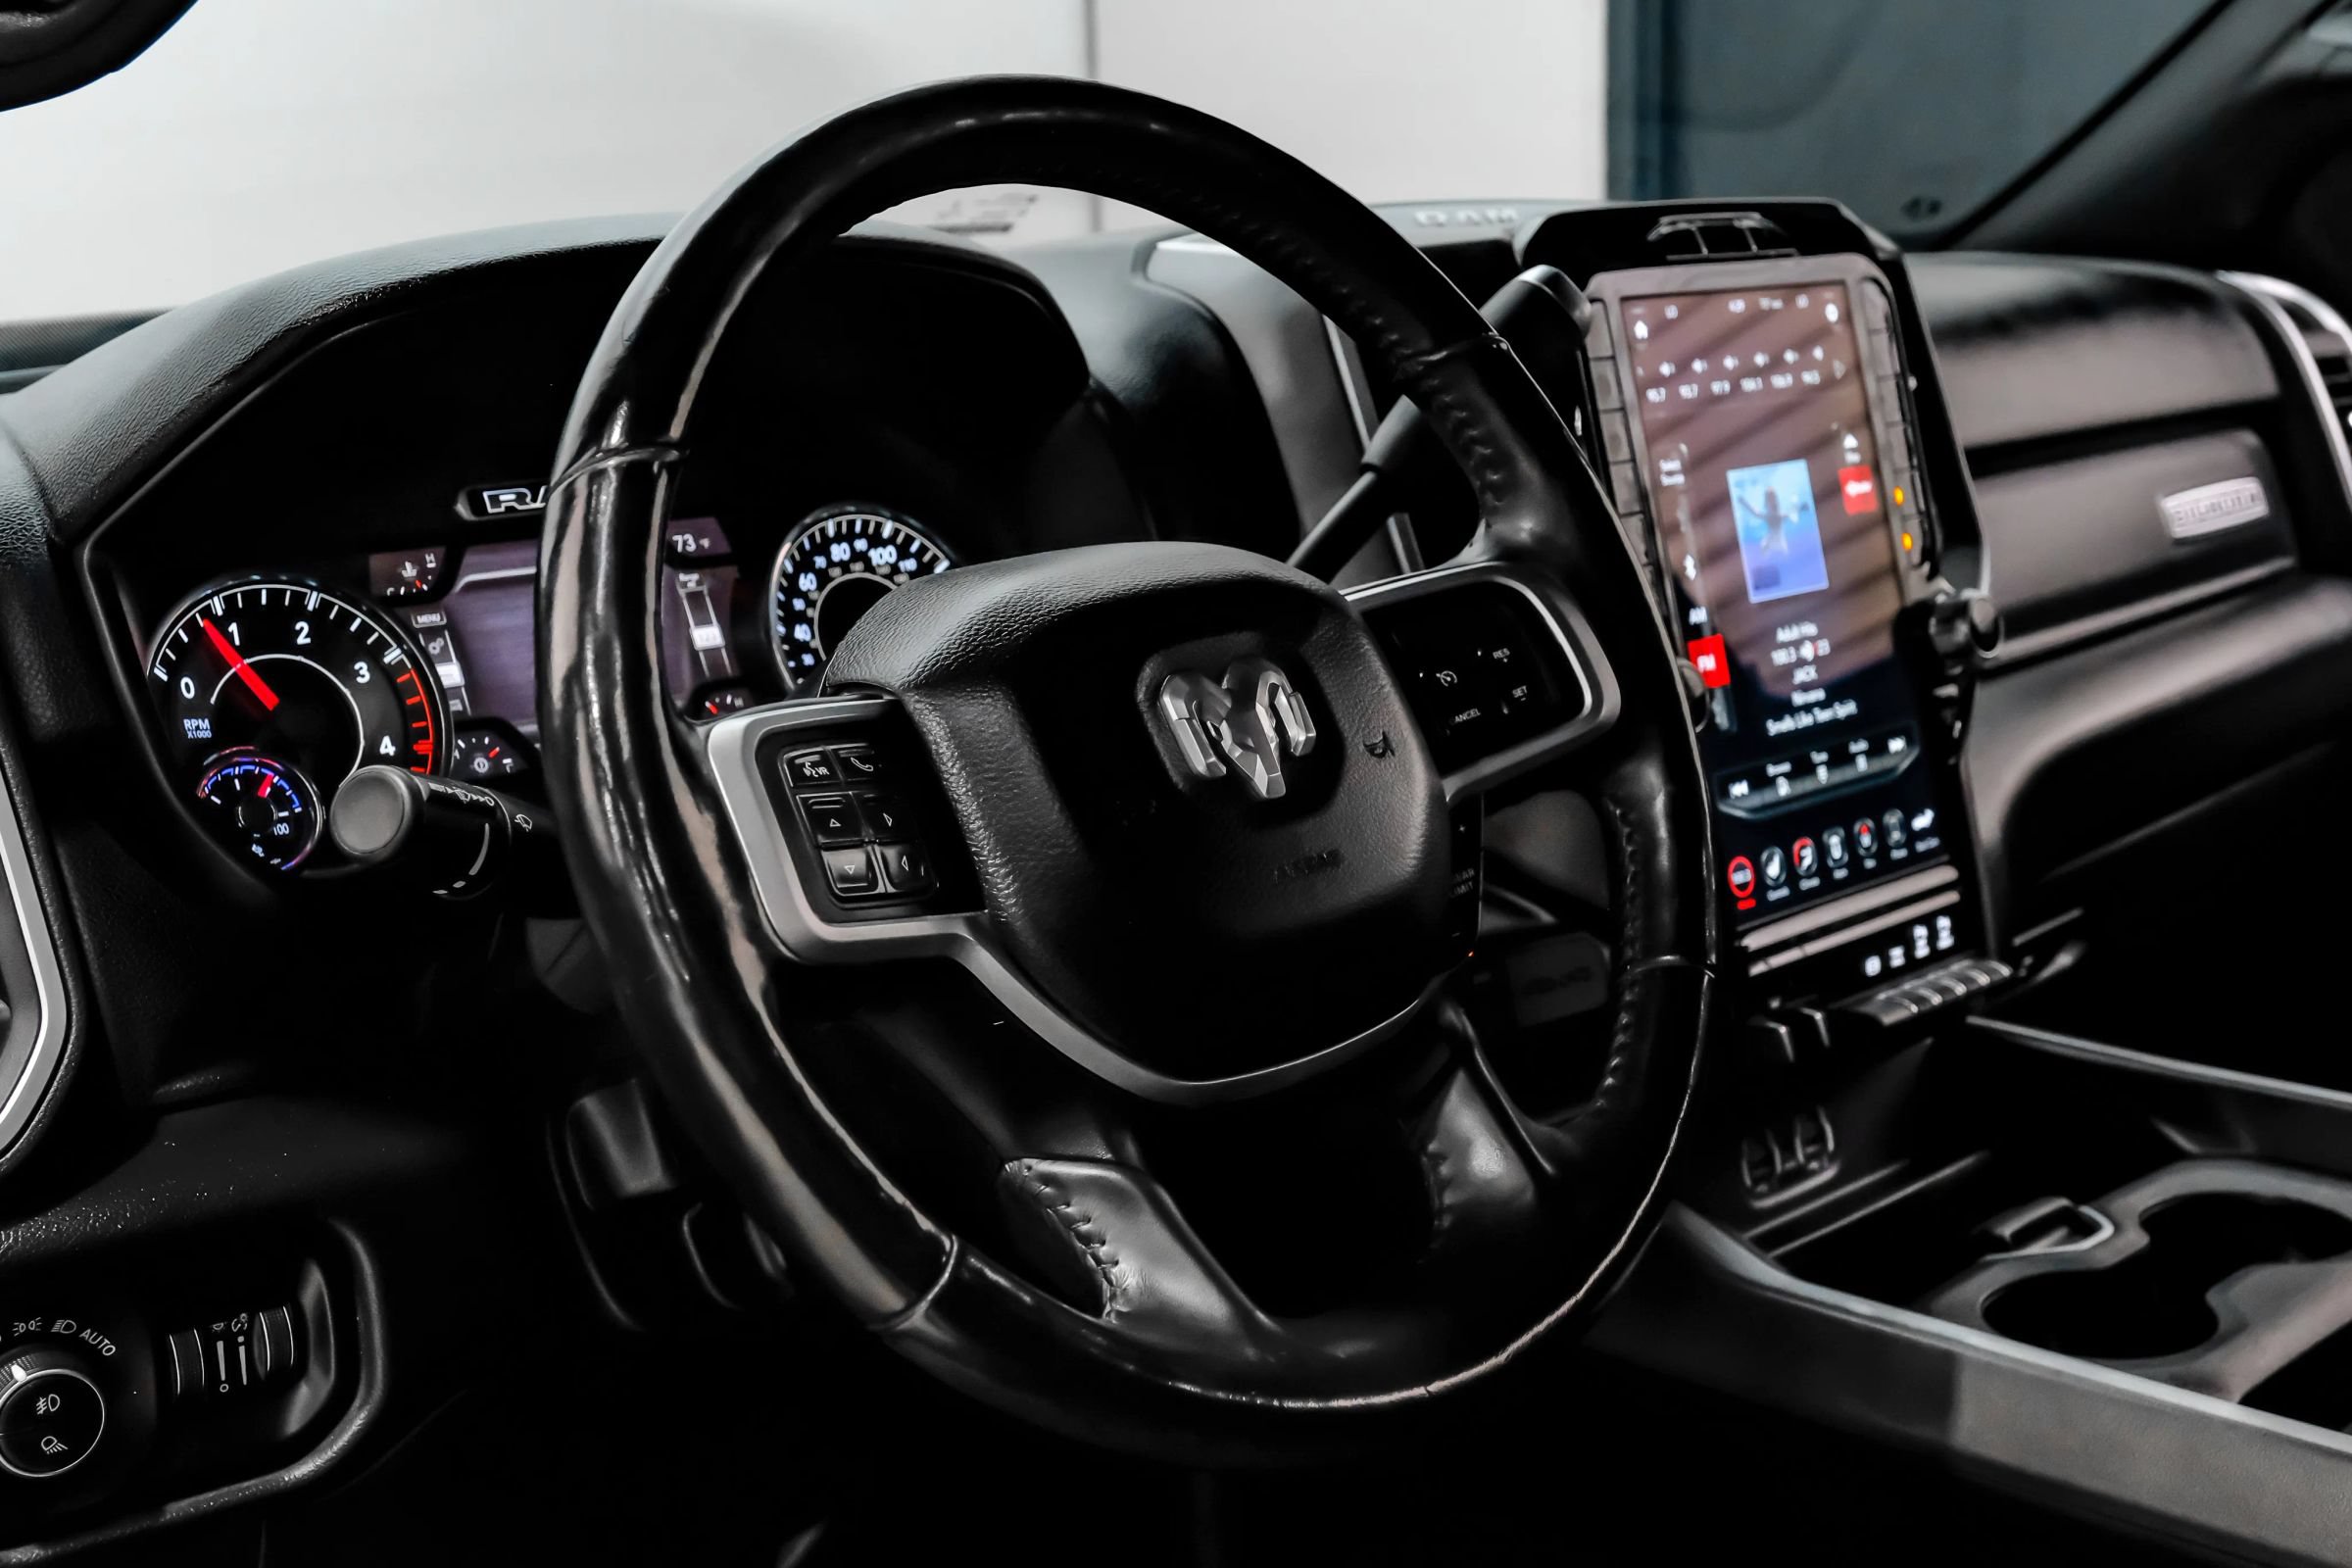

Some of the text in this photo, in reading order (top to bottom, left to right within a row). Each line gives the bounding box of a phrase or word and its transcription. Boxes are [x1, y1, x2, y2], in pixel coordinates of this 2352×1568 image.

[672, 533, 697, 553] 73
[829, 541, 851, 563] 80
[867, 544, 898, 567] 100
[799, 572, 817, 592] 60
[227, 622, 240, 646] 1
[294, 621, 312, 646] 2
[1493, 647, 1510, 660] RES
[354, 662, 370, 684] 3
[180, 676, 196, 700] 0
[1512, 685, 1529, 698] SET
[183, 718, 211, 730] RPM
[379, 736, 396, 757] 4
[815, 765, 830, 776] VR
[273, 822, 290, 837] 100
[78, 1328, 117, 1356] AUTO
